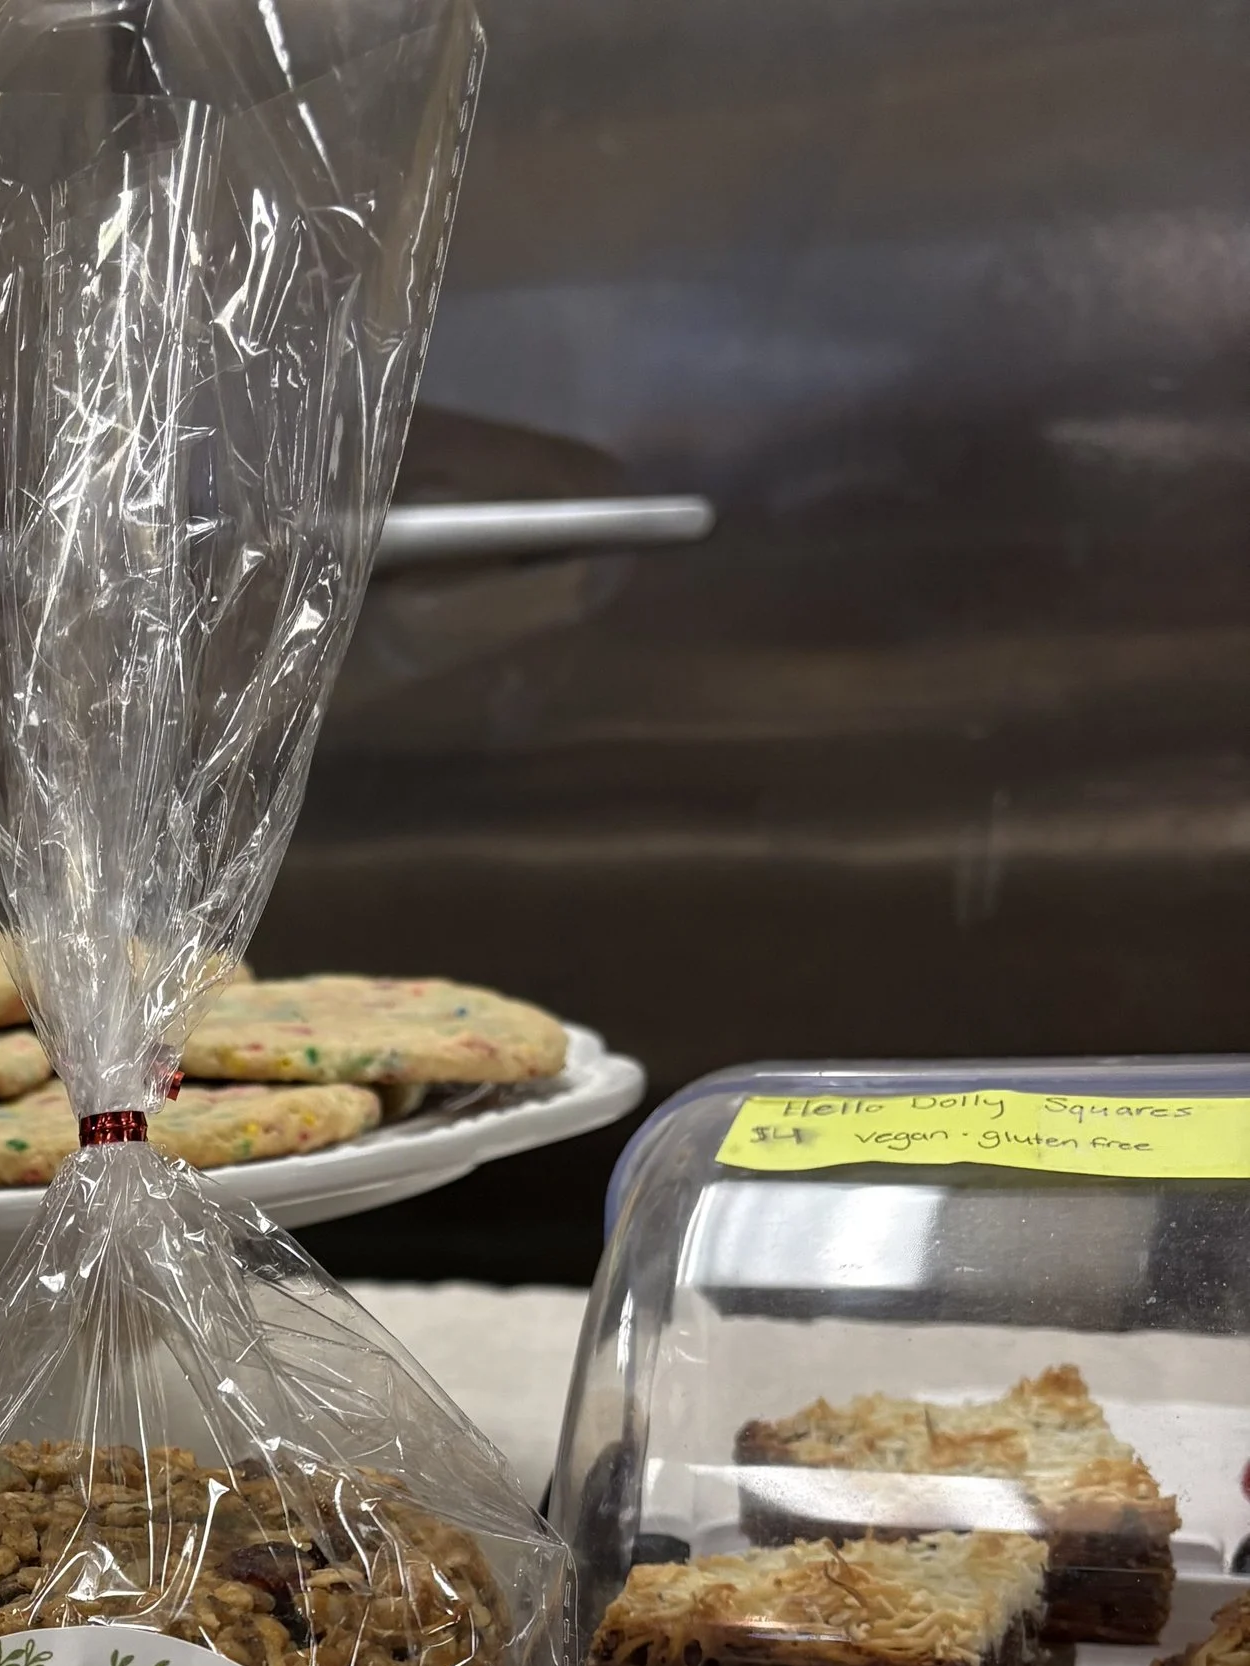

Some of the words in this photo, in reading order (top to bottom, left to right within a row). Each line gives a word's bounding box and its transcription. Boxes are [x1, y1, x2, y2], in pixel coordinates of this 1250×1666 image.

[782, 1099, 884, 1118] Hello
[911, 1093, 1005, 1120] Dolly
[1044, 1096, 1195, 1124] Squares
[749, 1125, 804, 1145] $4
[854, 1130, 949, 1152] vegan
[977, 1129, 1078, 1150] gluten
[1088, 1136, 1154, 1152] free
